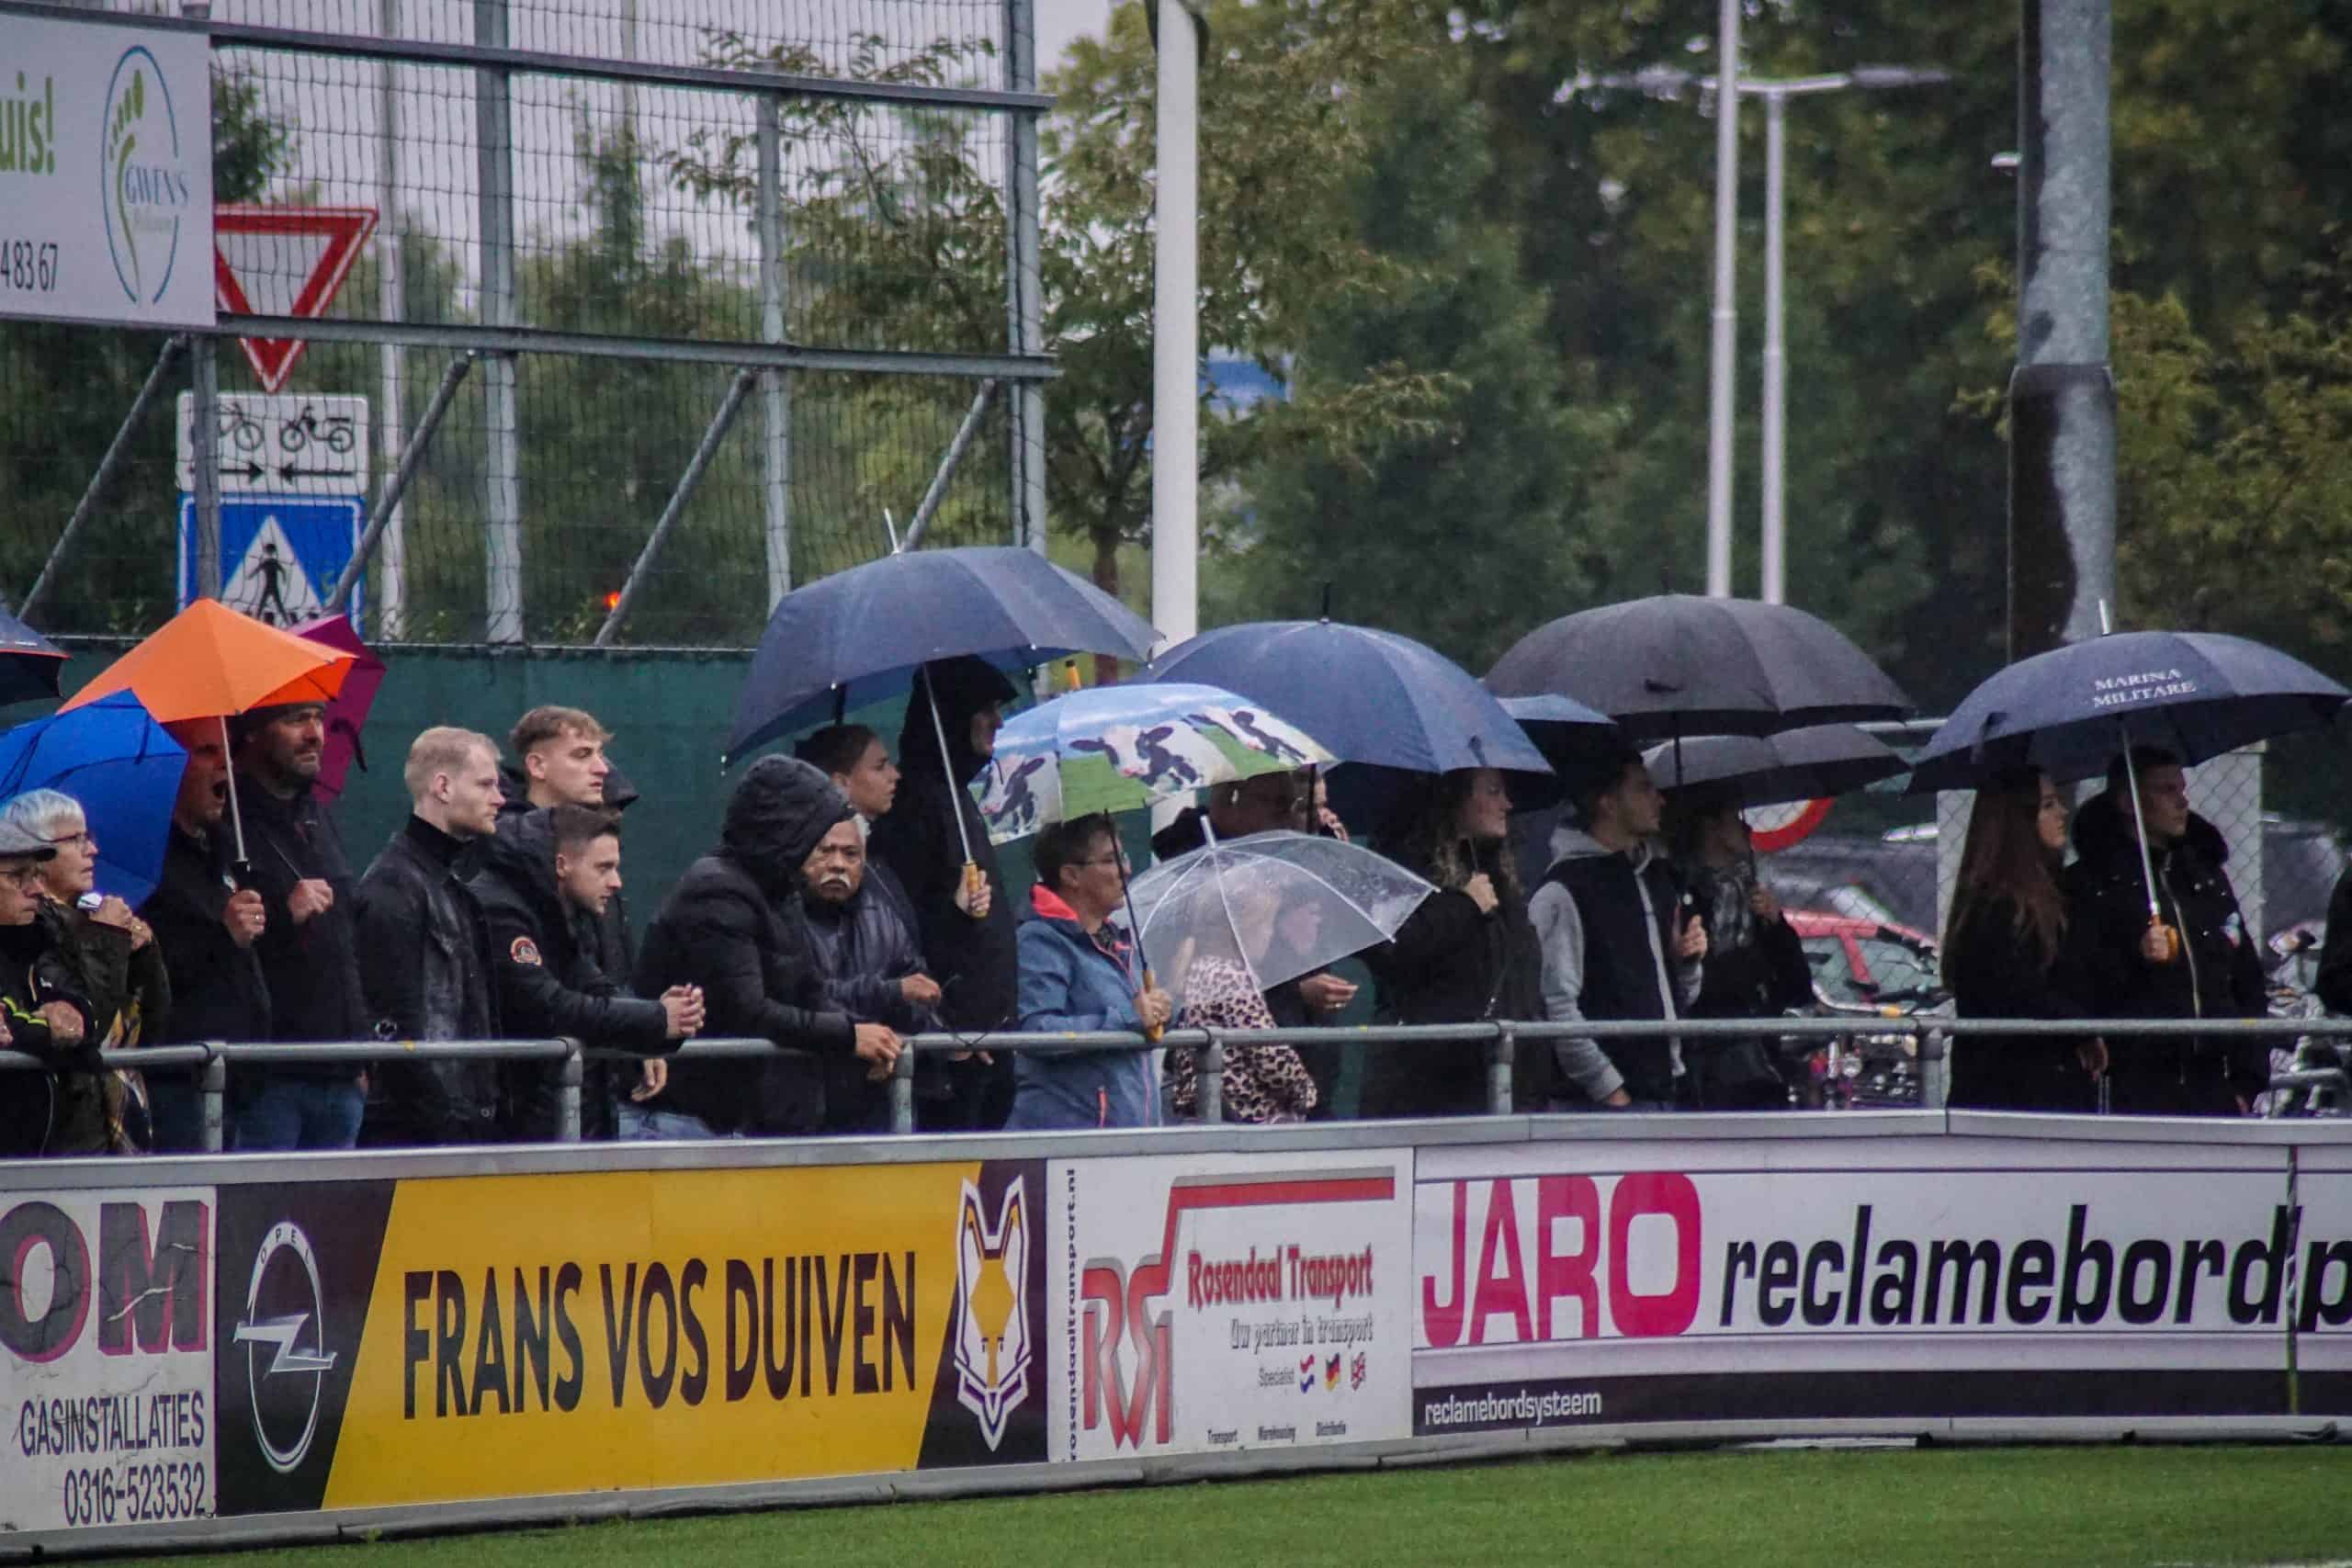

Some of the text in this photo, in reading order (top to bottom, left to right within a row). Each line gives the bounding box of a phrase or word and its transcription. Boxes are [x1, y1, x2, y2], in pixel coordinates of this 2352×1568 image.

[2092, 681, 2198, 708] MILITARE
[2094, 669, 2182, 691] MARINA
[1188, 1241, 1374, 1314] Rosendaal Transport
[1421, 1171, 1702, 1349] JARO
[403, 1261, 583, 1420] FRANS
[599, 1258, 708, 1409] VOS
[725, 1250, 916, 1403] DUIVEN
[1231, 1312, 1374, 1355] Uw partner in transport
[20, 1390, 205, 1456] GASINSTALLATIES
[1424, 1389, 1603, 1427] reclamebordsysteem
[63, 1462, 207, 1527] 0316-523532
